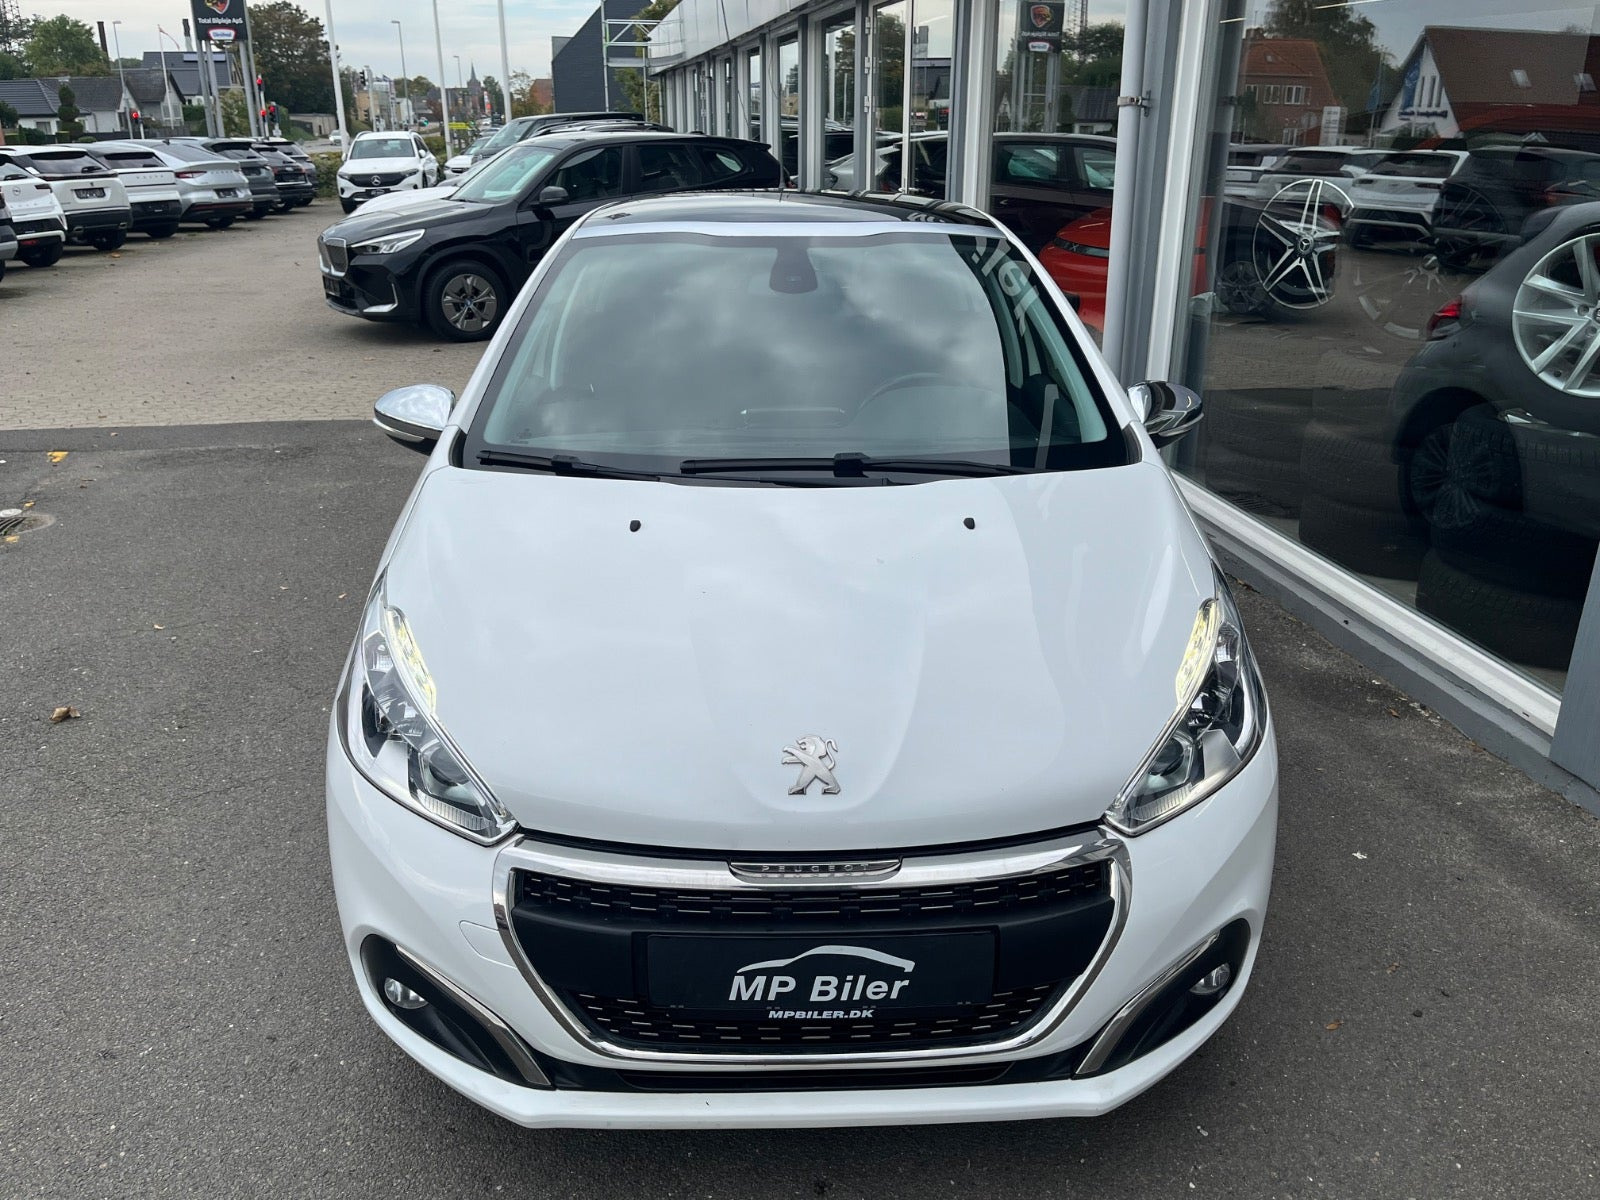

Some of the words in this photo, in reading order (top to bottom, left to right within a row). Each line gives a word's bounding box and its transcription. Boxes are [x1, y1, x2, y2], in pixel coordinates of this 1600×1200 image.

[761, 863, 869, 872] PEUGEOT
[728, 975, 796, 1001] MP
[809, 974, 910, 1002] Biler
[768, 1009, 875, 1019] MPBILER.DK
